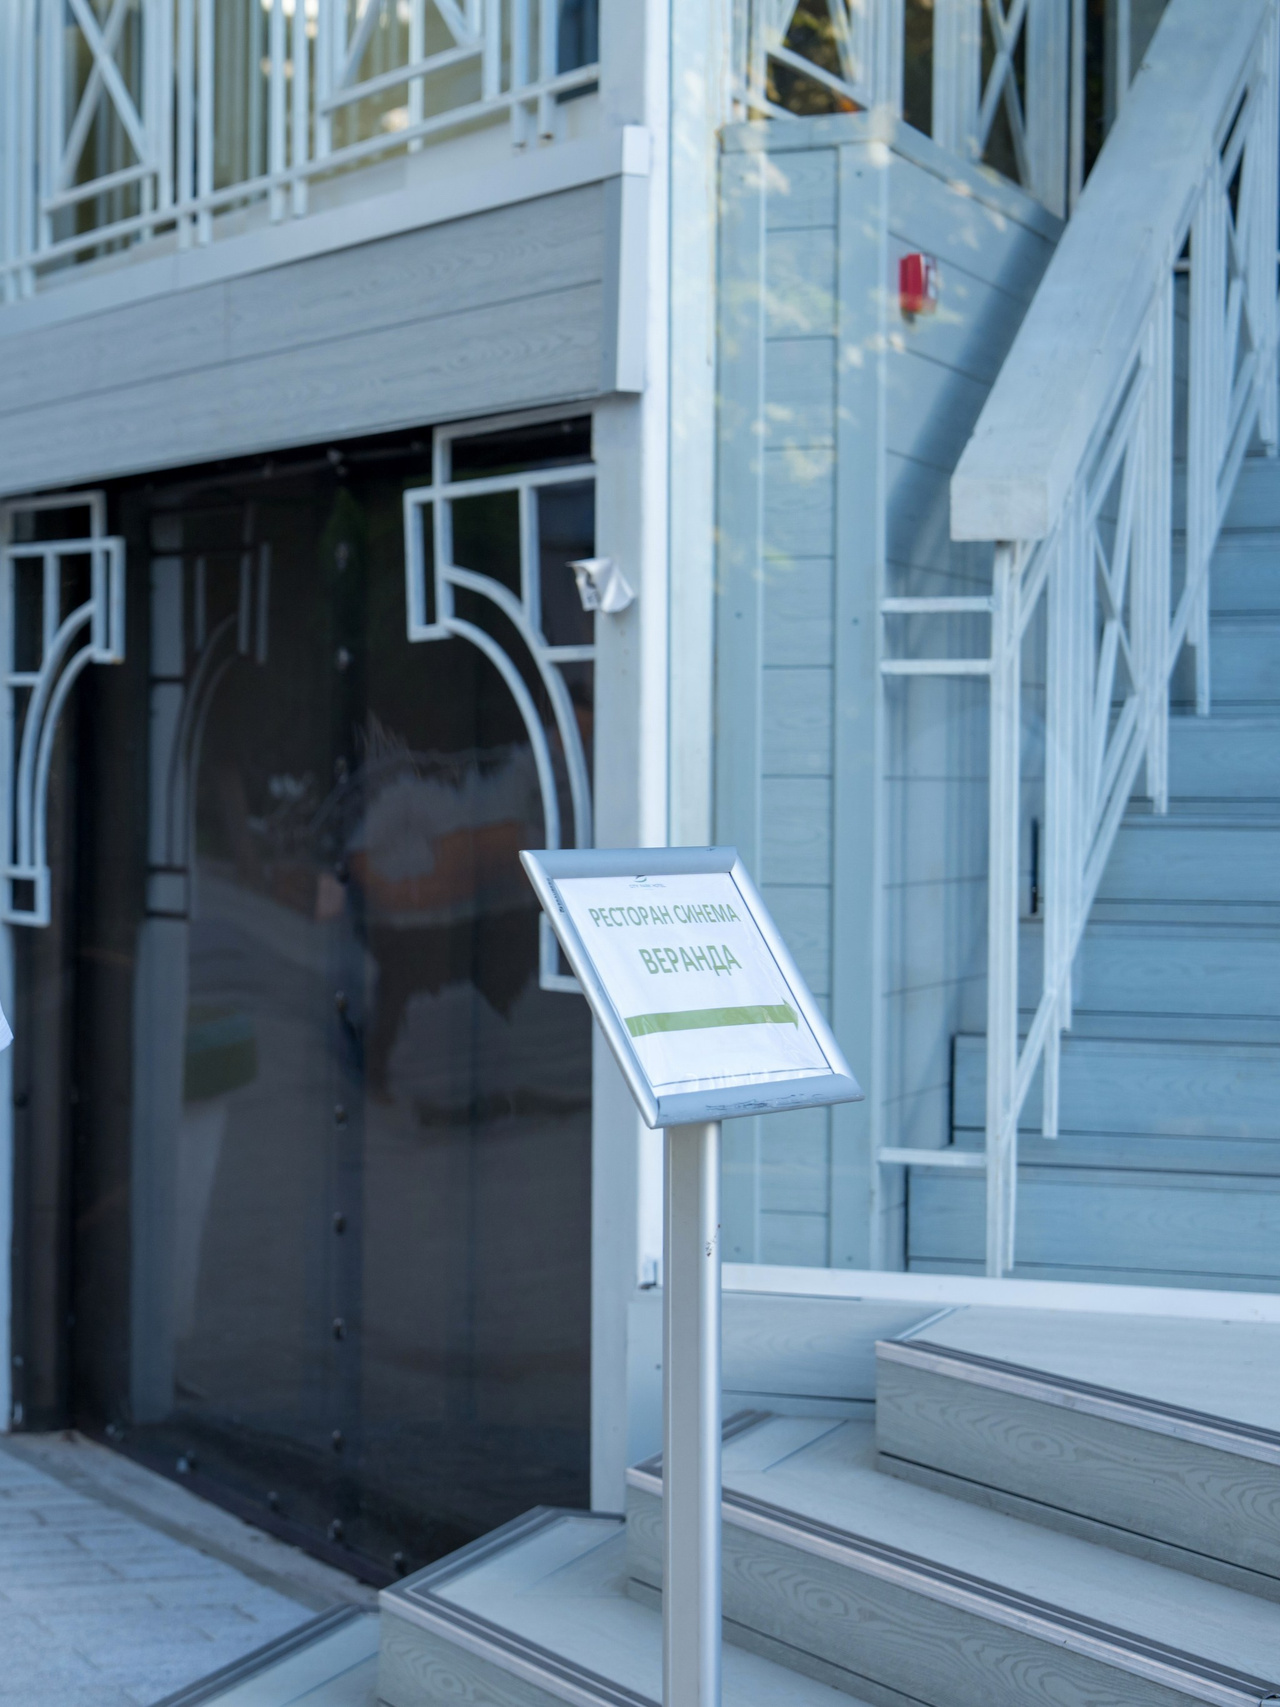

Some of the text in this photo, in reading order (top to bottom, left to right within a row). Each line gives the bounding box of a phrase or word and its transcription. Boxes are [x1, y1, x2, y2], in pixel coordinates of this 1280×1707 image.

[588, 904, 741, 927] РЕСТОРАН СИНЕМА
[638, 944, 742, 976] ВЕРАНДА
